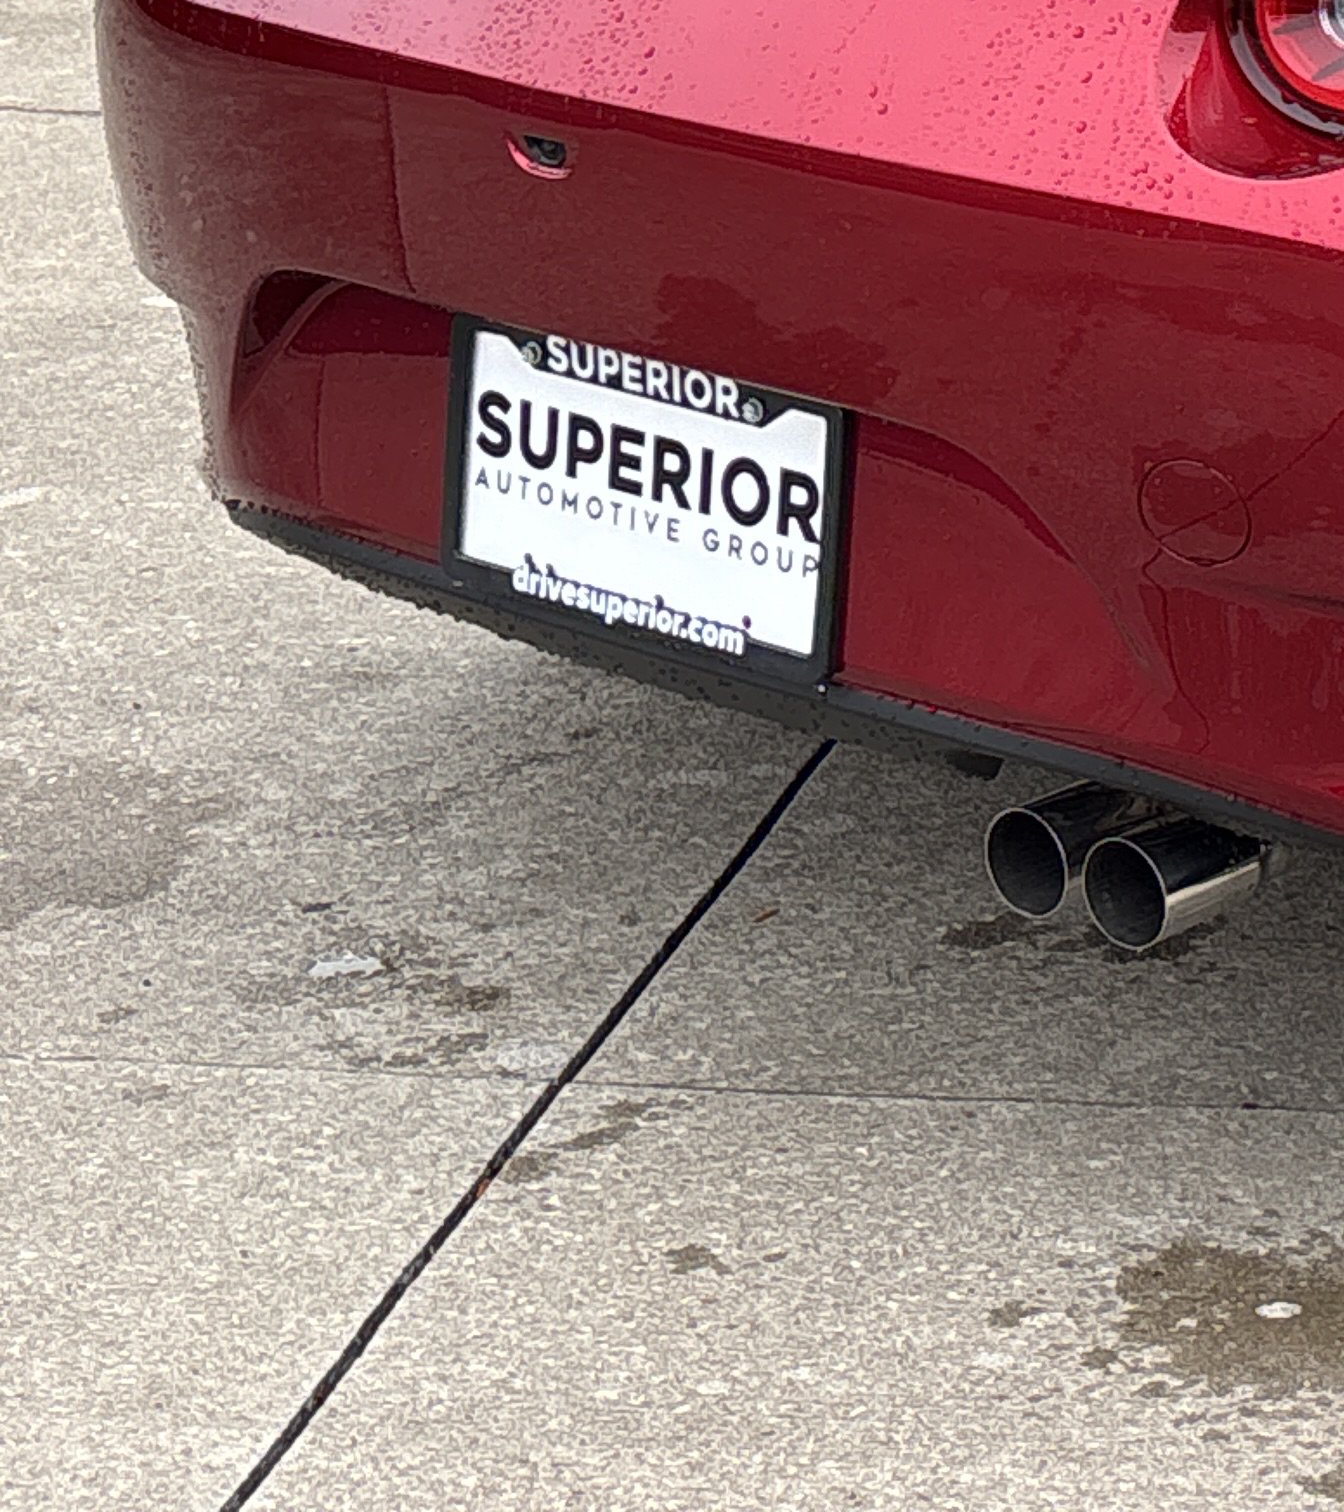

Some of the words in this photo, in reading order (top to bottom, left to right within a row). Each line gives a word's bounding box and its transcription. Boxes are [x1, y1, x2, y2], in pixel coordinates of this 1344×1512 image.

[546, 335, 740, 419] SUPERIOR
[475, 390, 820, 545] SUPERIOR
[475, 466, 681, 543] AUTOMOTIVE
[702, 528, 821, 578] GROUP
[511, 560, 746, 656] drivesuperior.com
